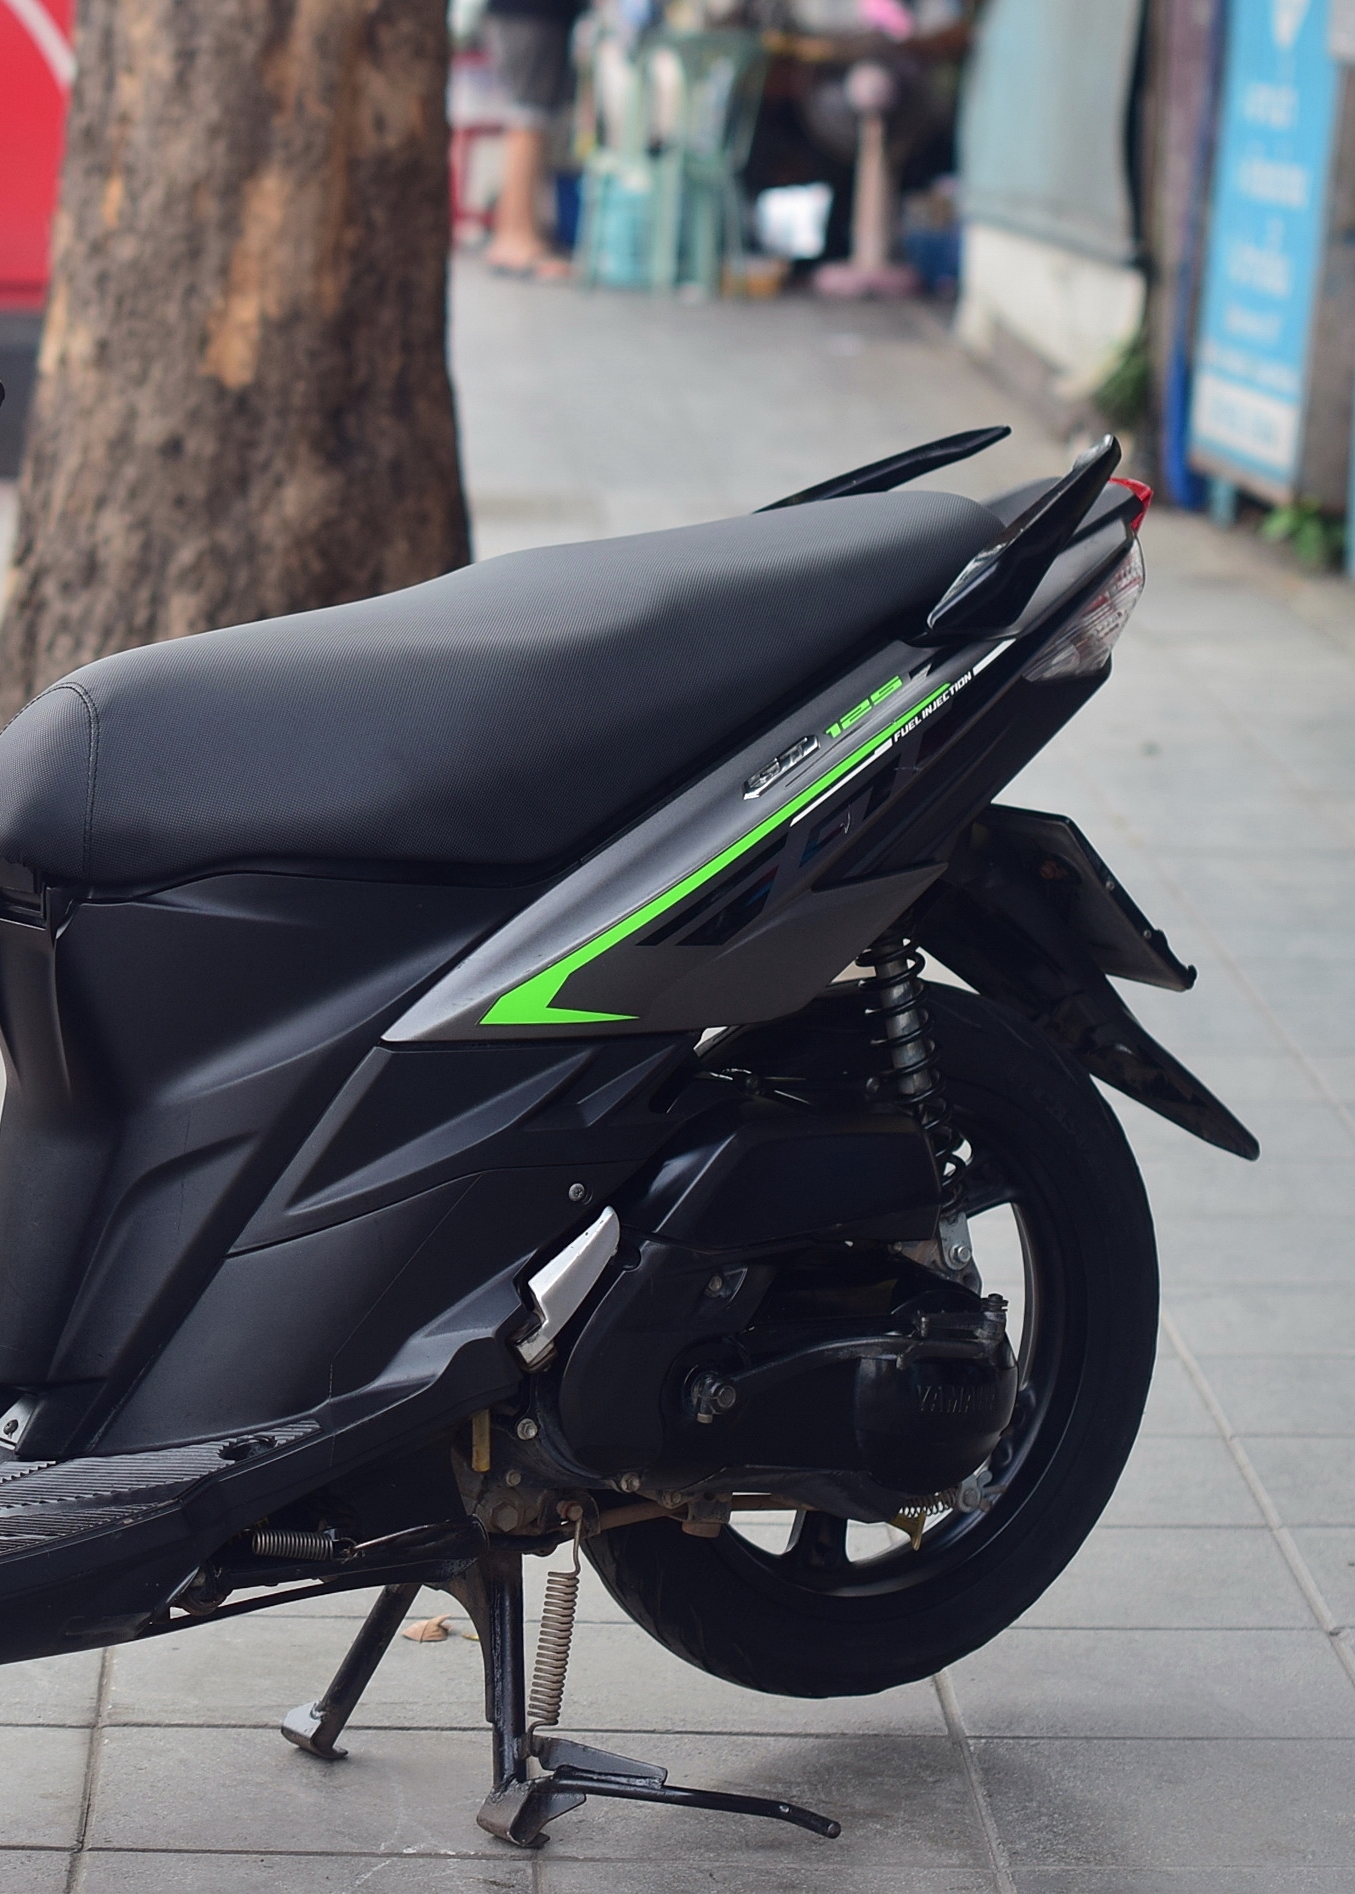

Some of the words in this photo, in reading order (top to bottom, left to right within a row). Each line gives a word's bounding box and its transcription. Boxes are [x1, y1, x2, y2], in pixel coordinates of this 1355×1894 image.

[825, 675, 903, 738] 125
[893, 716, 922, 743] FUEL
[921, 671, 972, 720] INJECTION
